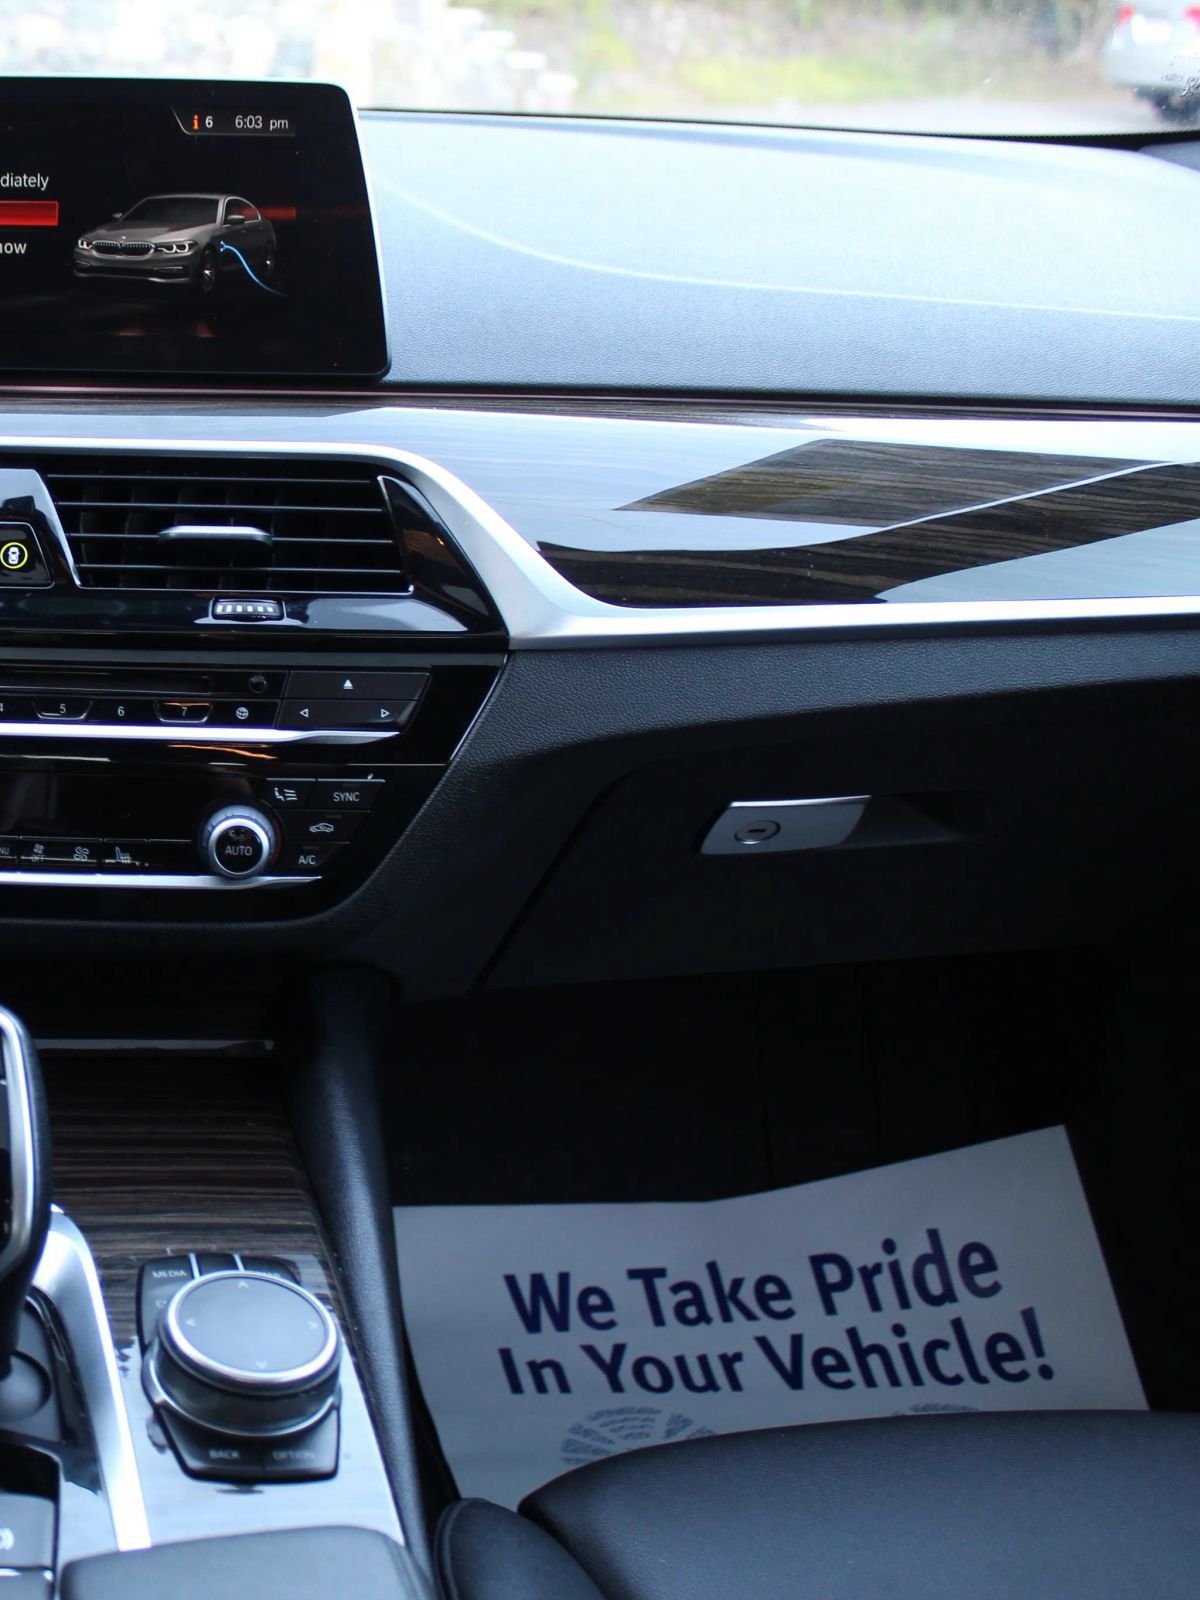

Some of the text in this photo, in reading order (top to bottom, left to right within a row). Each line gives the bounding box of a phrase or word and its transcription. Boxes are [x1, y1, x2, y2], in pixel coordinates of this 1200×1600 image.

[205, 115, 213, 128] 6
[235, 115, 263, 129] 6:03
[269, 119, 289, 131] pm
[59, 703, 67, 715] 5
[117, 706, 125, 717] 6
[181, 707, 188, 718] 7
[333, 792, 361, 802] SYNC
[225, 846, 253, 856] AUTO
[298, 855, 316, 865] A/C
[152, 1269, 187, 1279] MEDIA
[503, 1228, 1002, 1334] We Take Pride
[498, 1306, 1055, 1395] In Your Vehicle!
